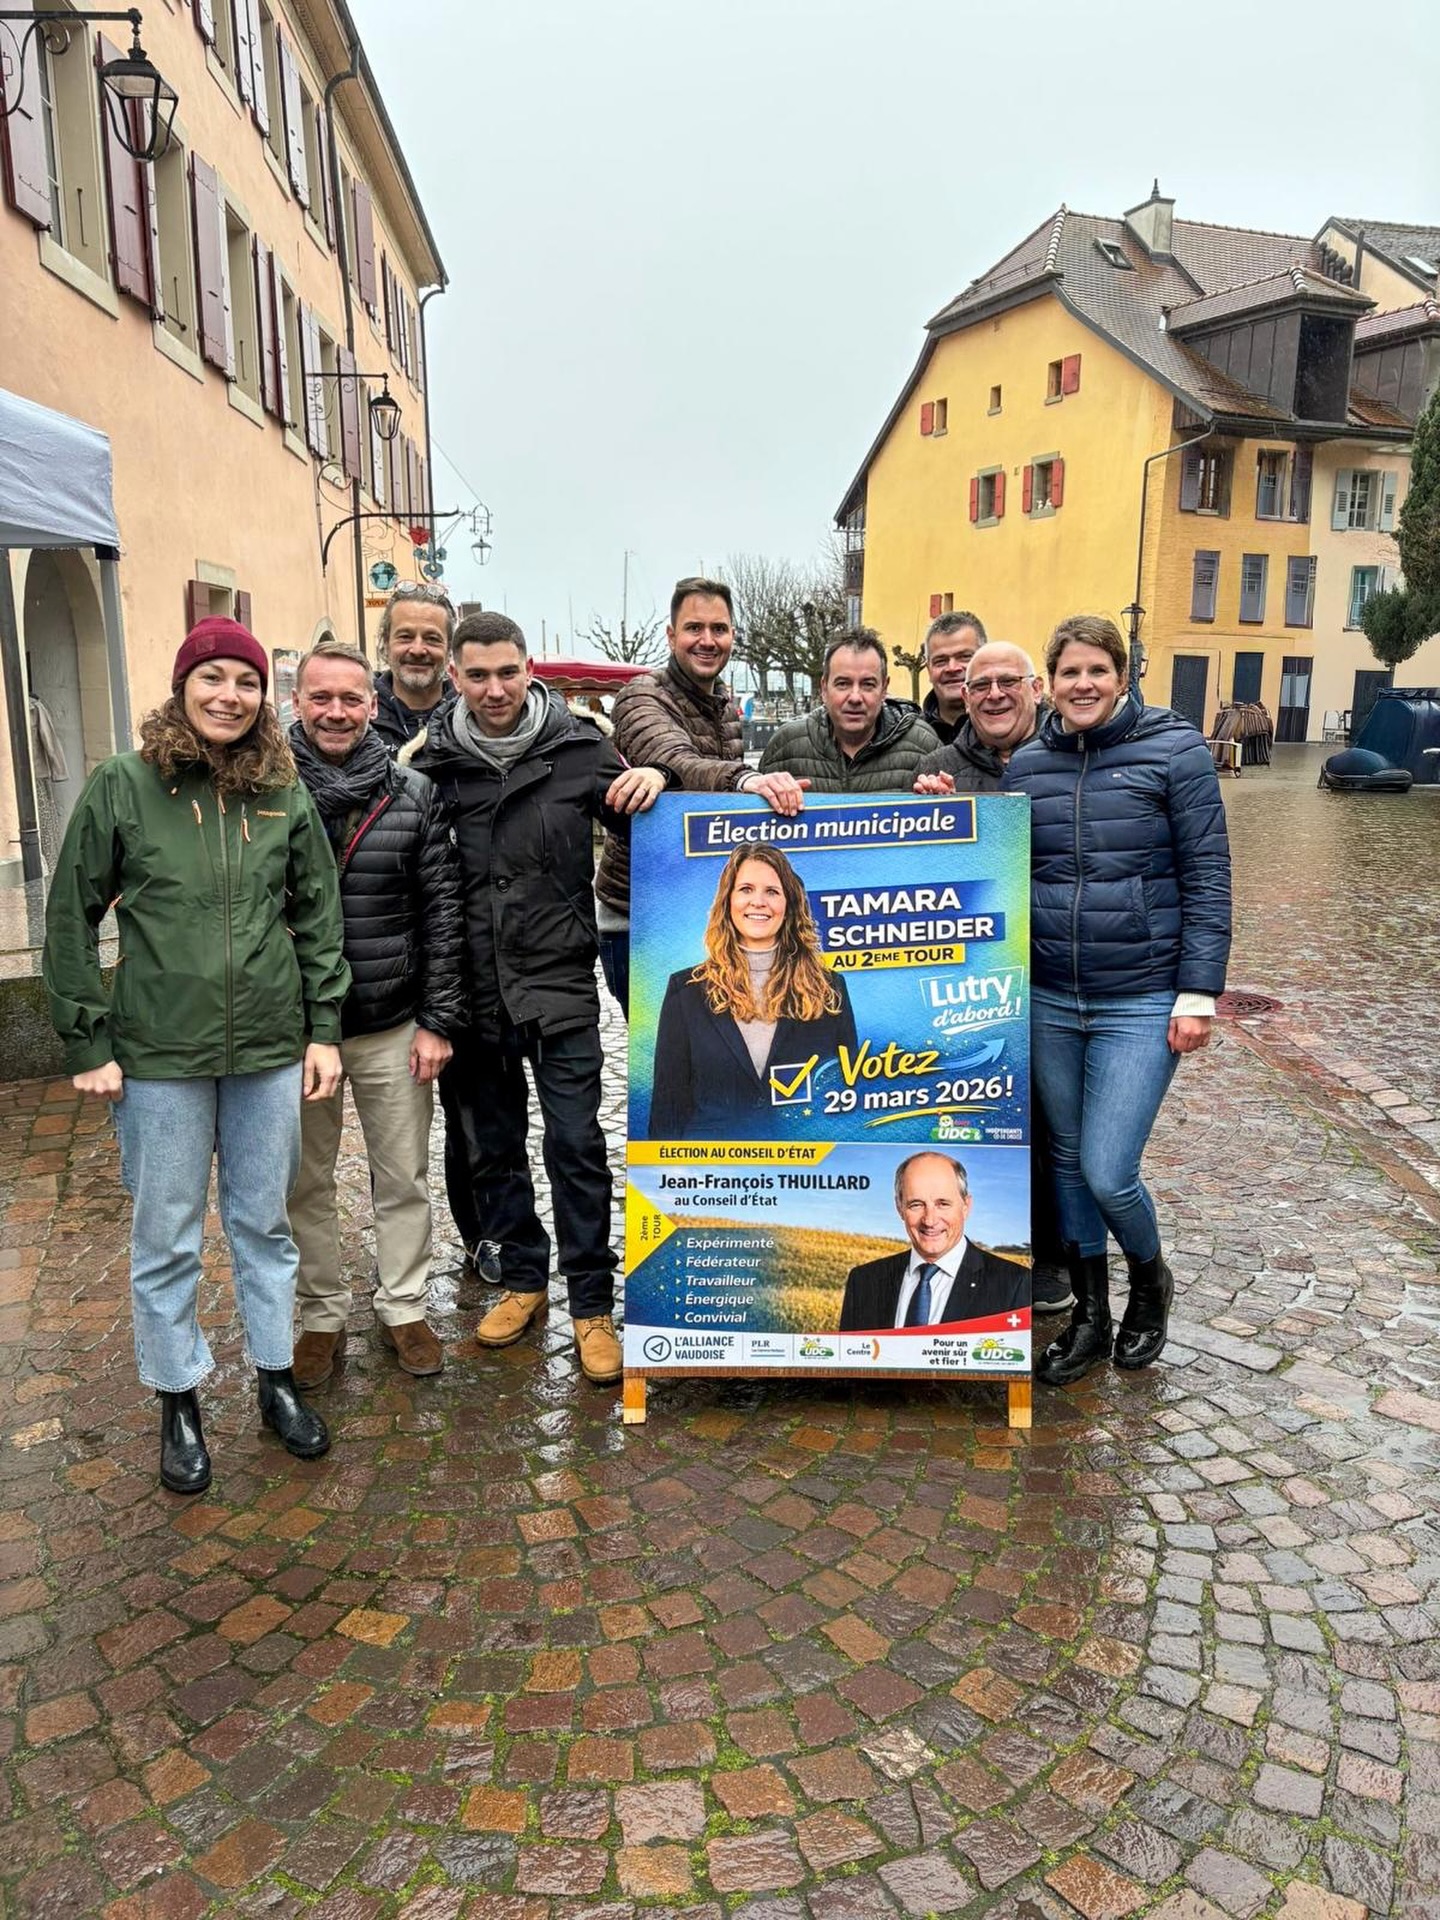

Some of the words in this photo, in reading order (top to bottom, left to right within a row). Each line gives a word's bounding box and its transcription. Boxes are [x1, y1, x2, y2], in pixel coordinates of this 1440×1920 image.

[707, 815, 809, 845] Élection
[818, 809, 956, 840] municipale
[820, 887, 961, 918] TAMARA
[828, 916, 995, 947] SCHNEIDER
[833, 954, 857, 969] AU
[861, 951, 900, 967] 2EME
[904, 947, 954, 964] TOUR
[929, 973, 1012, 1008] Lutry
[838, 1039, 945, 1087] Votez
[823, 1090, 857, 1114] 29
[864, 1086, 930, 1110] mars
[938, 1128, 970, 1140] UDC
[659, 1146, 708, 1158] ÉLECTION
[711, 1148, 726, 1158] AU
[728, 1148, 773, 1159] CONSEIL
[777, 1146, 816, 1159] D'ÉTAT
[659, 1174, 774, 1192] Jean-François
[777, 1174, 870, 1190] THUILLARD
[674, 1197, 690, 1206] au
[692, 1194, 737, 1206] Conseil
[740, 1192, 778, 1206] d'État
[653, 1214, 661, 1239] TOUR
[686, 1236, 775, 1251] Expérimenté
[685, 1256, 761, 1268] Fédérateur
[686, 1275, 756, 1286] Travailleur
[685, 1292, 754, 1308] Énergique
[684, 1311, 747, 1323] Convivial
[674, 1336, 735, 1347] L'ALLIANCE
[933, 1339, 954, 1347] Pour
[675, 1349, 725, 1360] VAUDOISE
[805, 1347, 826, 1355] UDC
[922, 1348, 951, 1356] avenir
[953, 1347, 967, 1356] sûr
[980, 1347, 1014, 1360] UDC
[930, 1358, 940, 1366] et
[942, 1356, 959, 1366] fier
